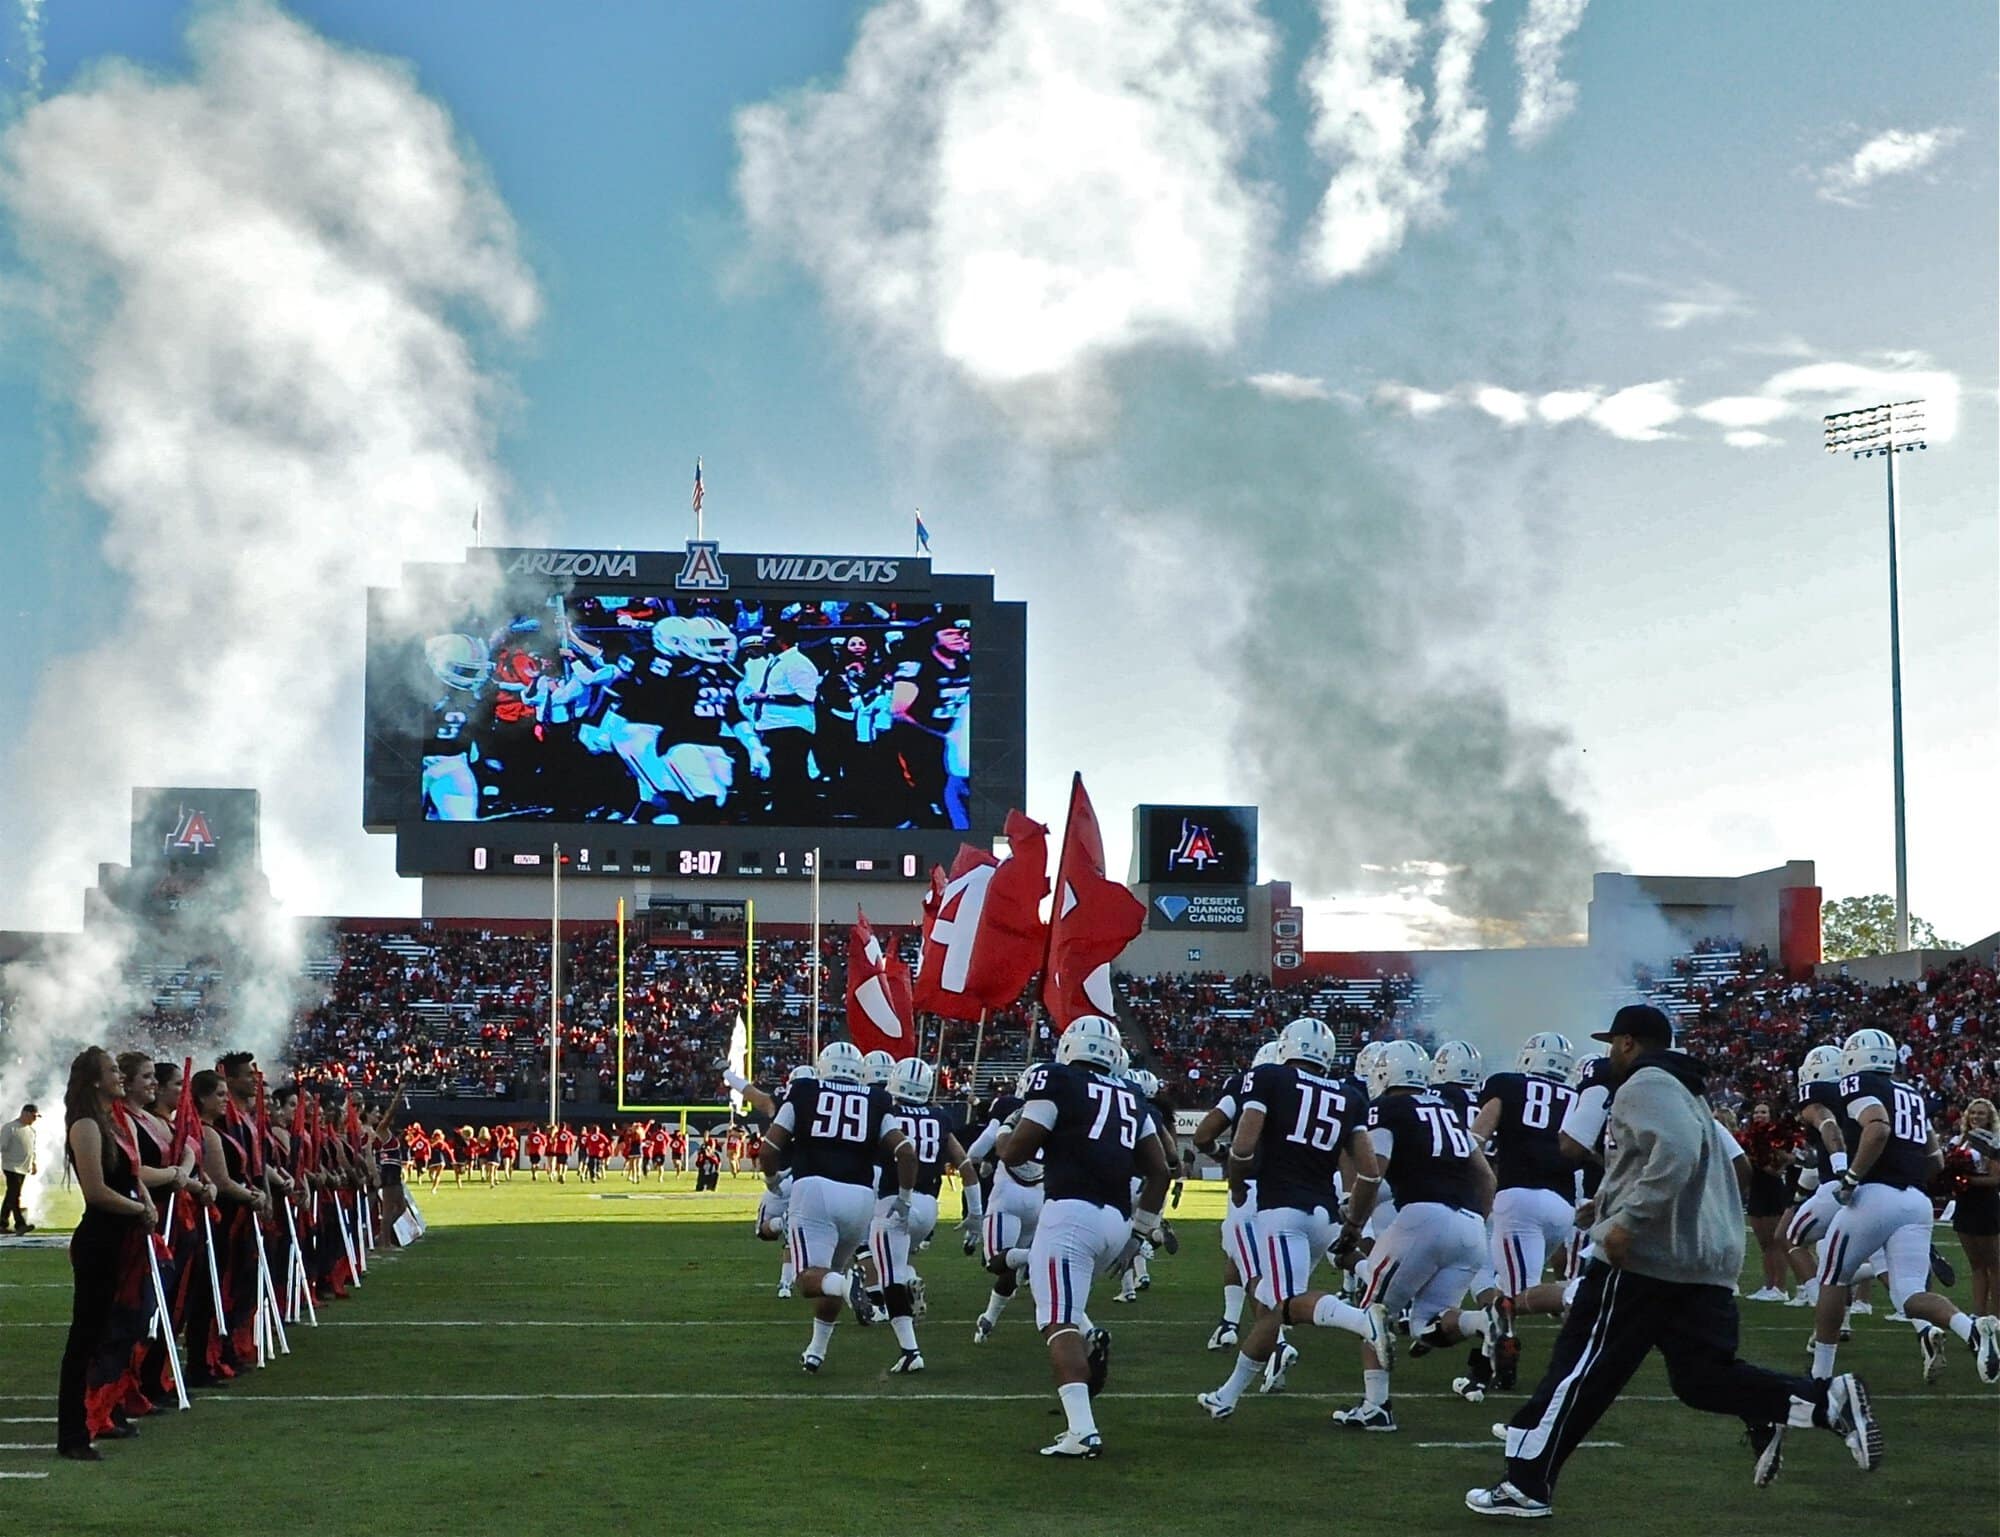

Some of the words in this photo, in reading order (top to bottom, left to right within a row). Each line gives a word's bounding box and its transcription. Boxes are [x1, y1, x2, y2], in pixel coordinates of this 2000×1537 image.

[507, 553, 637, 577] ARIZONA
[675, 540, 729, 590] A
[756, 558, 899, 583] WILDCATS
[474, 848, 487, 870] 0
[679, 851, 722, 874] 3:07
[779, 852, 786, 866] 1
[903, 855, 916, 877] 0
[1187, 905, 1245, 914] DIAMOND
[1193, 896, 1240, 905] DESERT
[1189, 914, 1243, 923] CASINOS
[692, 929, 704, 940] 12
[1839, 1076, 1860, 1097] 83
[811, 1091, 871, 1143] 99
[1087, 1082, 1138, 1150] 75
[1286, 1083, 1347, 1152] 15
[1522, 1081, 1580, 1134] 87
[1894, 1087, 1928, 1145] 83
[1416, 1106, 1470, 1159] 76
